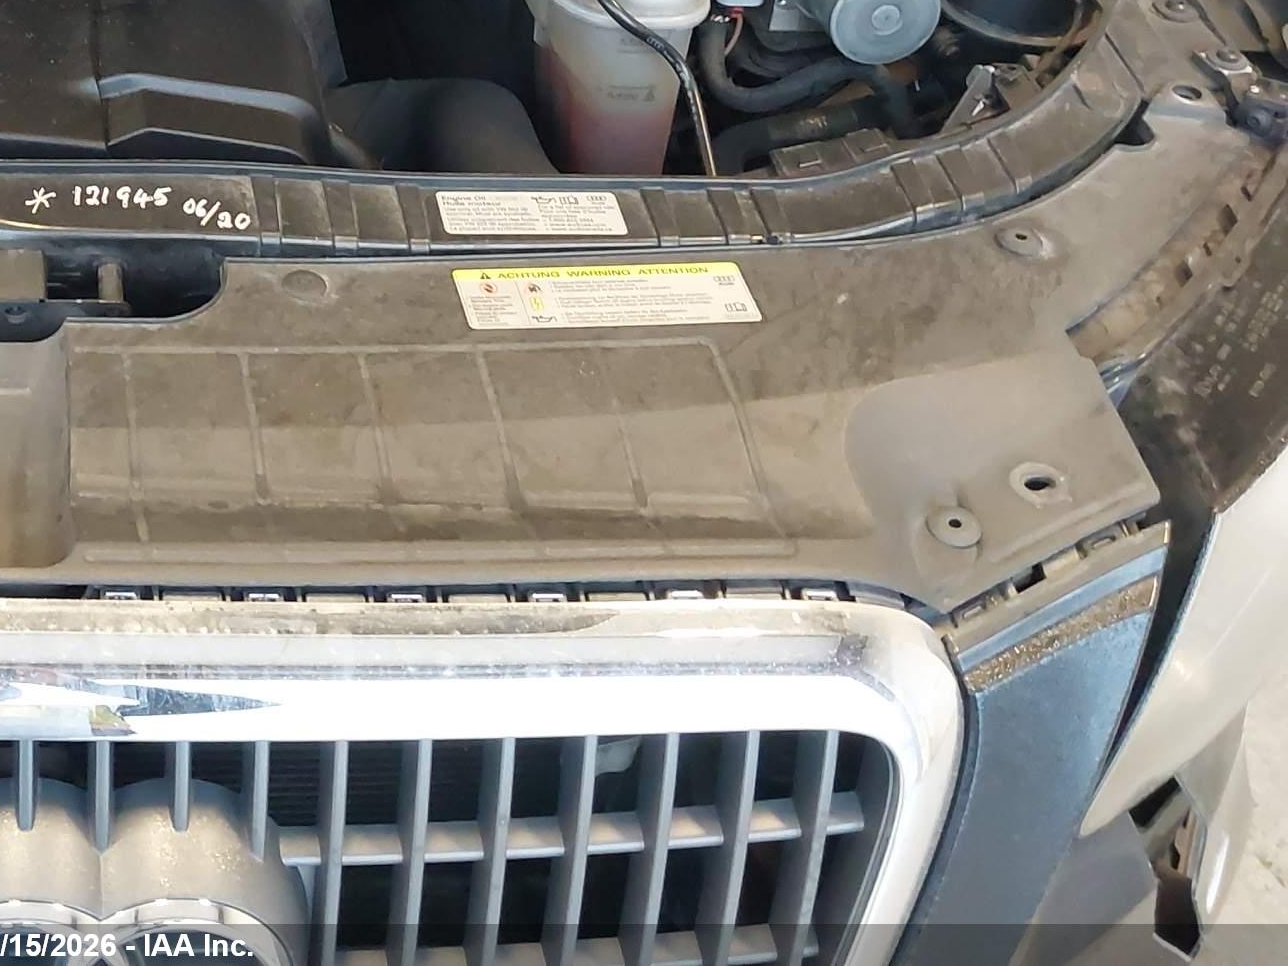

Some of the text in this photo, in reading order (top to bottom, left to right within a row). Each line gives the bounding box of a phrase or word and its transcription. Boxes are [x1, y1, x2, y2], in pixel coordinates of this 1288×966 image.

[182, 197, 251, 230] 06/20
[498, 266, 708, 279] ACHTUNG WARNING ATTENTION
